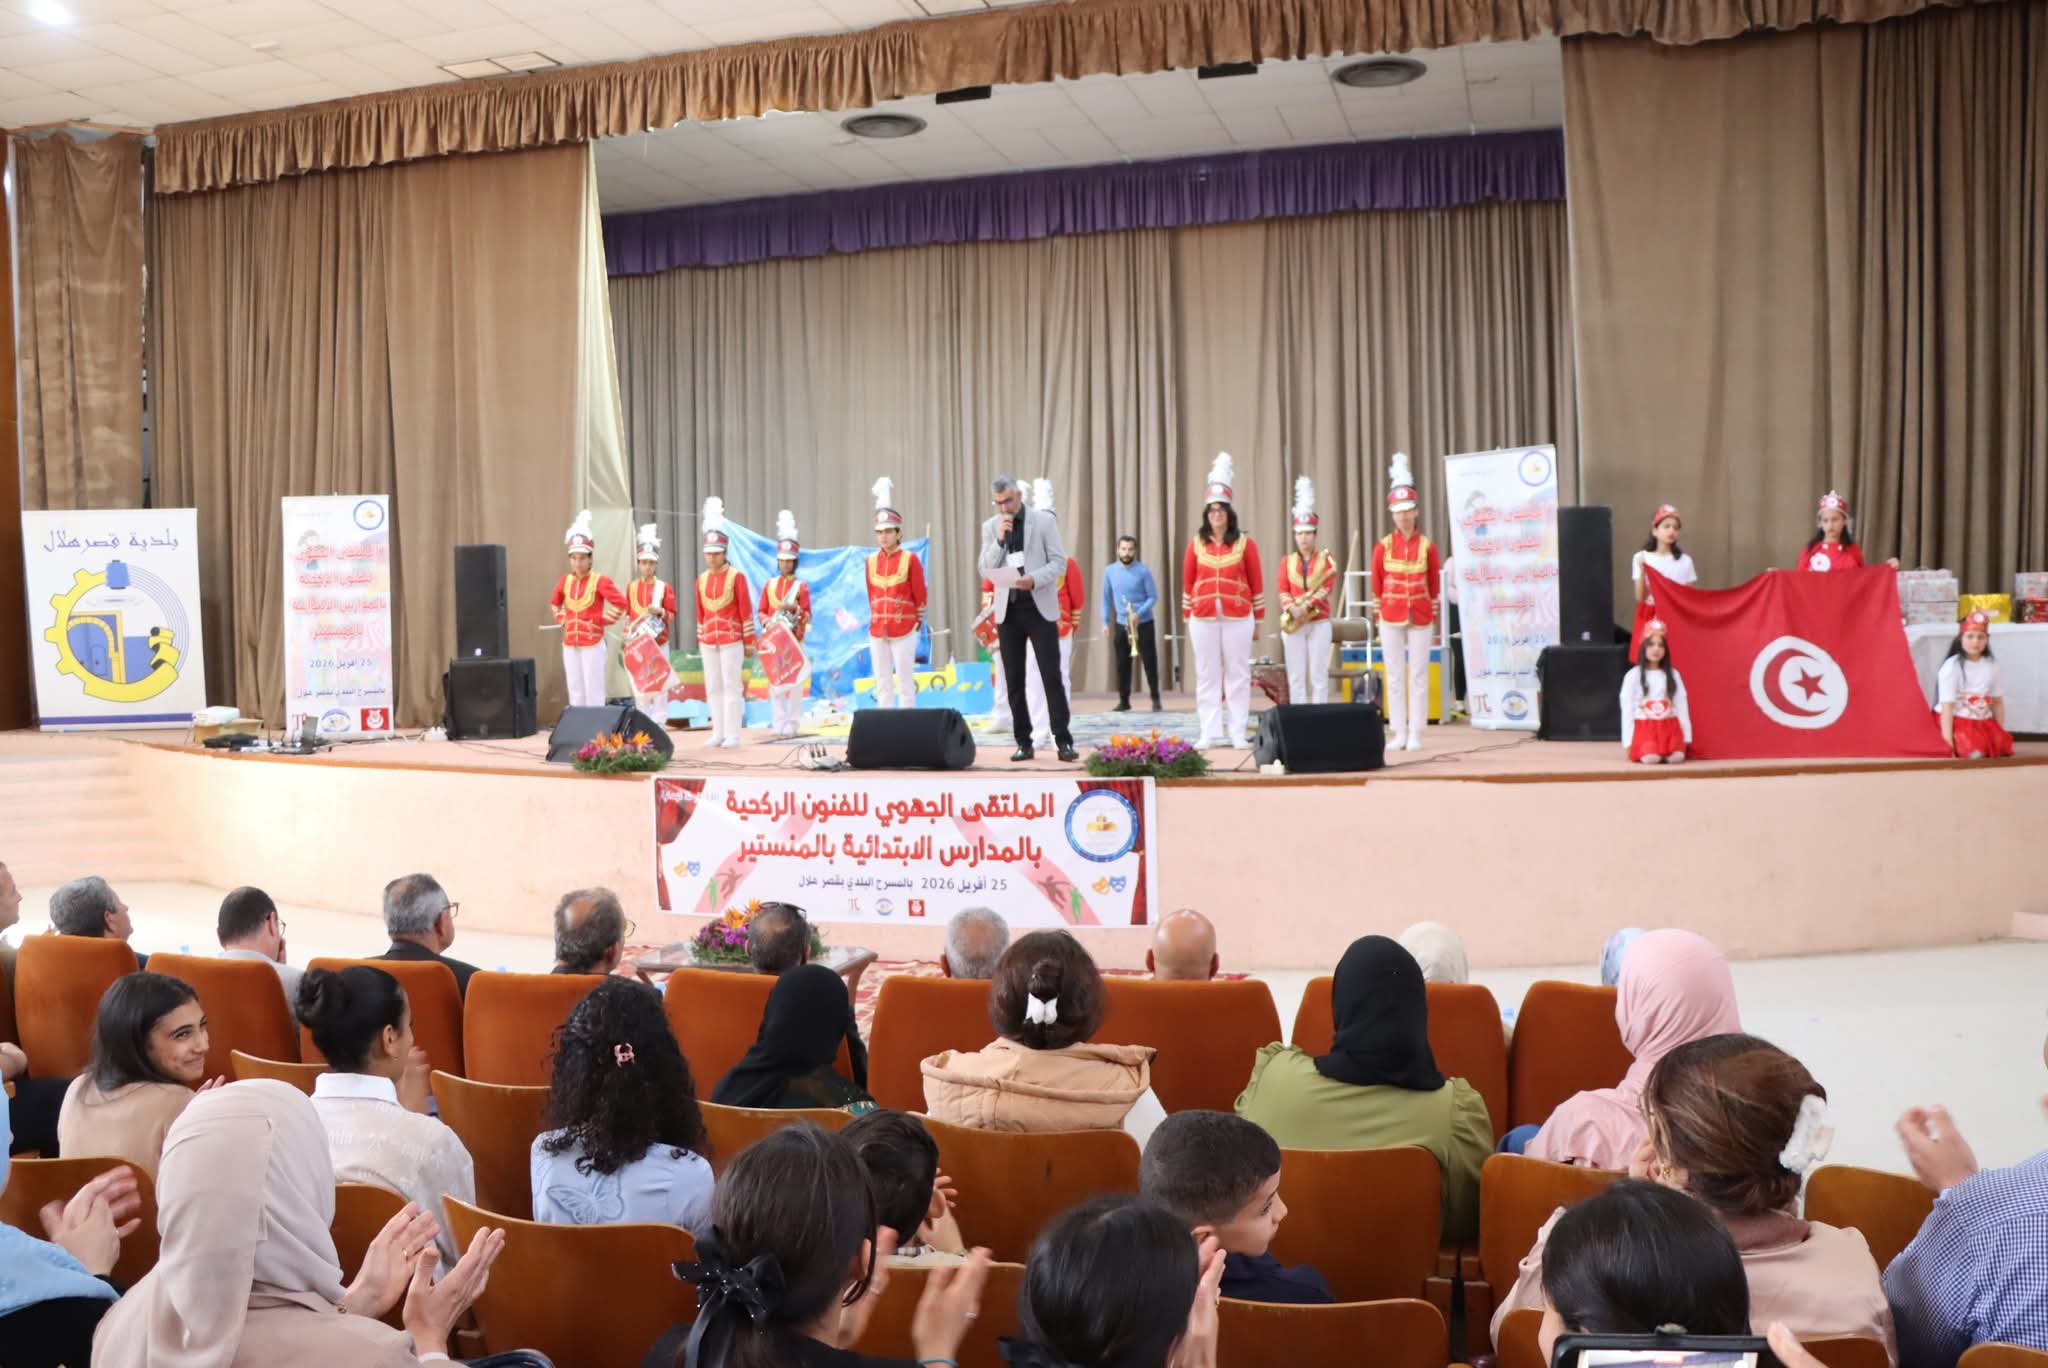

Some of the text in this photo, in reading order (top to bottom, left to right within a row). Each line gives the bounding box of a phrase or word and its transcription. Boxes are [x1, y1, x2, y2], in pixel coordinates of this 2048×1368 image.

[129, 528, 179, 551] بلدية
[310, 659, 334, 668] 2026
[726, 789, 1055, 828] الملتقى الجهوي للفنون الركحية
[737, 832, 1042, 868] بالمدارس الابتدائية بالمنستير
[847, 876, 874, 891] البلدي
[875, 877, 913, 891] بالمسرح
[921, 877, 954, 890] 2026
[957, 876, 987, 893] أفريل
[991, 878, 1008, 890] 25
